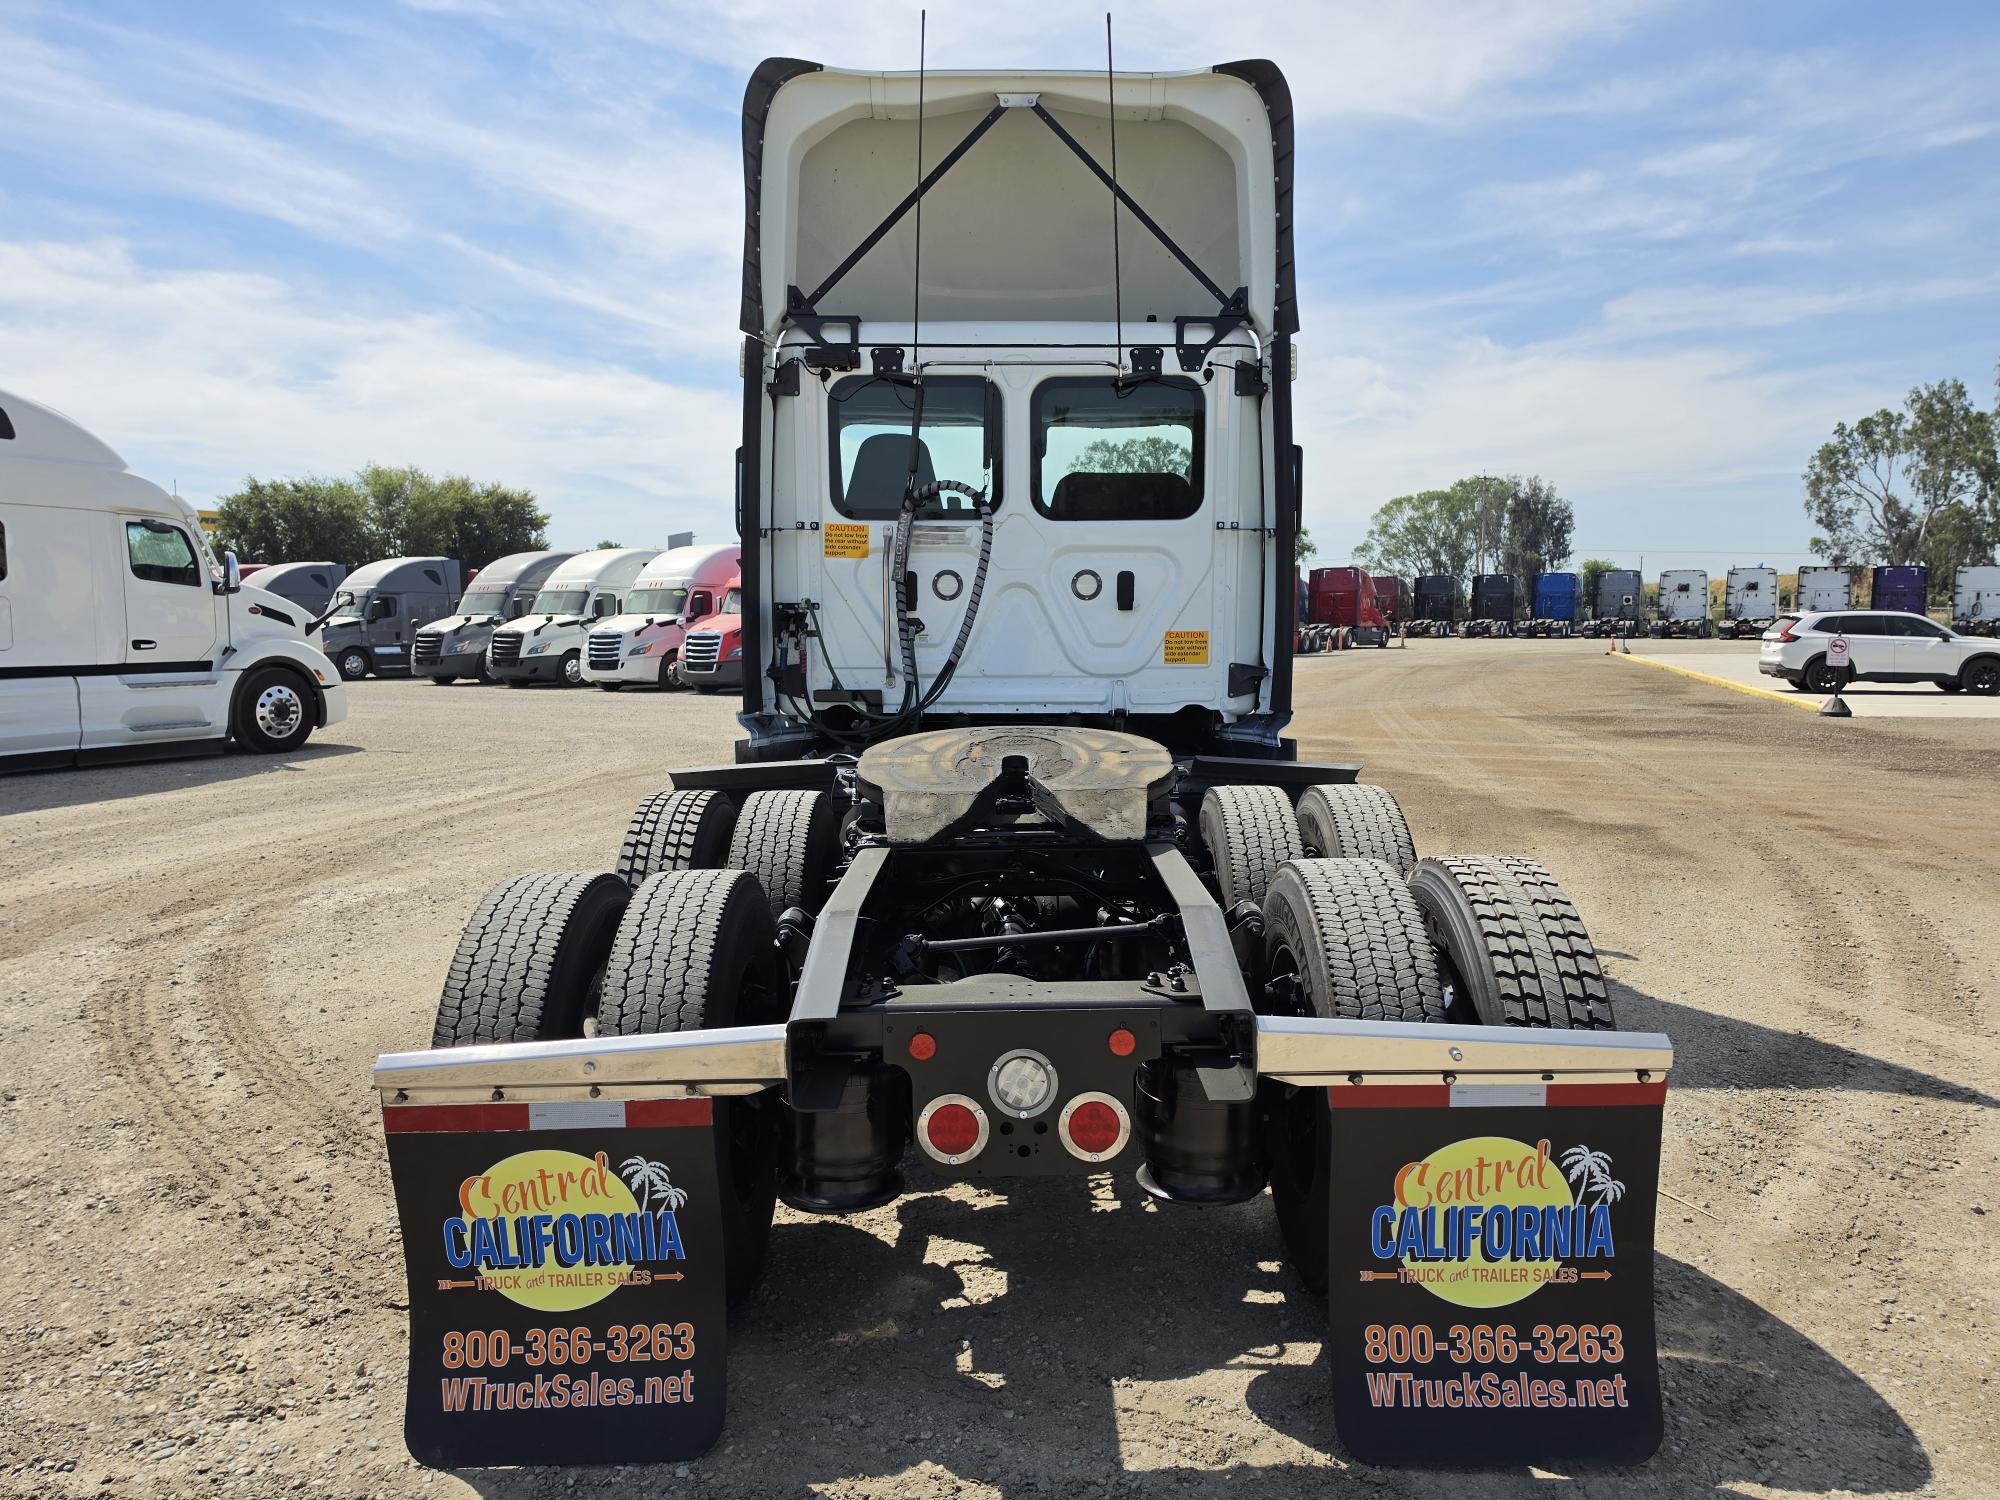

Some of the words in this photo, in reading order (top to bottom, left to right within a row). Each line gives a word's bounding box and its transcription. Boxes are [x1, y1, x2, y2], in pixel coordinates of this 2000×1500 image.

[829, 524, 865, 532] CAUTION
[895, 513, 907, 568] TECTRAN
[459, 1151, 615, 1222] Central
[1394, 1138, 1552, 1211] Central
[443, 1211, 686, 1268] CALIFORNIA
[1371, 1204, 1615, 1259] CALIFORNIA
[475, 1274, 522, 1290] TRUCK
[525, 1270, 545, 1289] and
[548, 1274, 603, 1288] TRAILER
[607, 1270, 652, 1287] SALES
[1398, 1268, 1444, 1283] TRUCK
[1449, 1267, 1469, 1283] and
[1472, 1268, 1528, 1283] TRAILER
[1533, 1267, 1578, 1283] SALES
[442, 1323, 695, 1369] 800-366-3263
[1364, 1324, 1624, 1364] 800-366-3263
[441, 1369, 694, 1412] WTruckSales.net
[1366, 1372, 1629, 1408] WTruckSales.net
